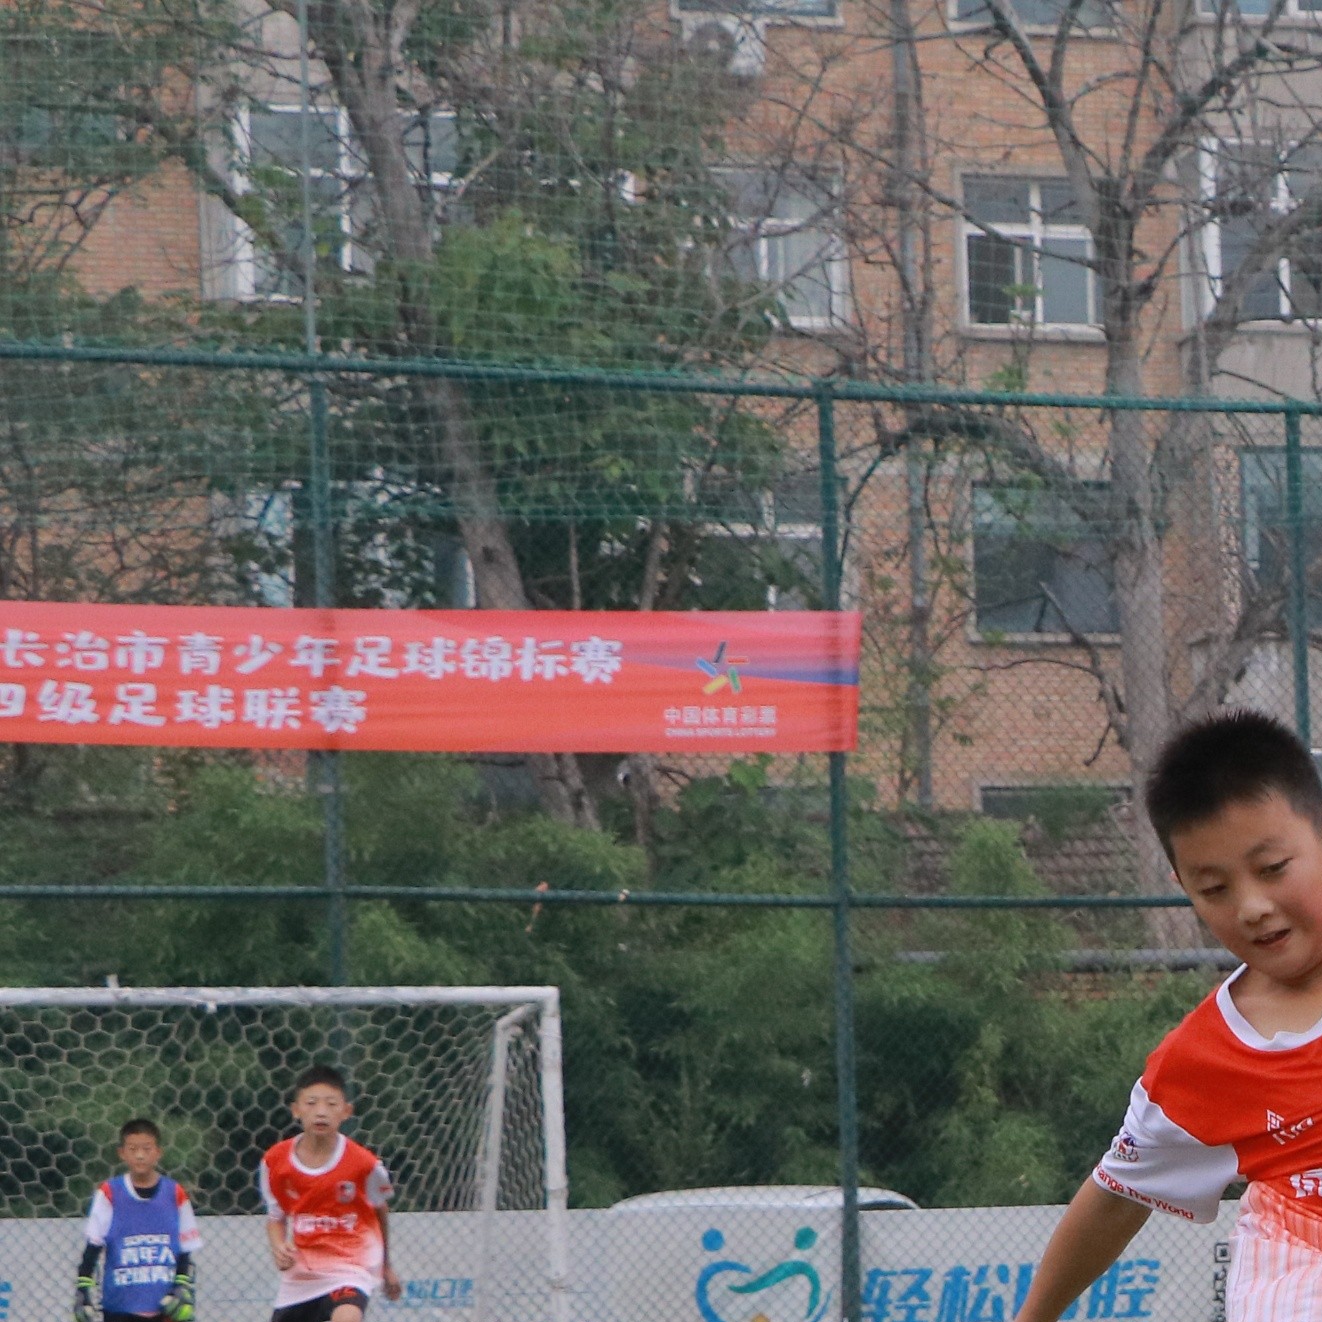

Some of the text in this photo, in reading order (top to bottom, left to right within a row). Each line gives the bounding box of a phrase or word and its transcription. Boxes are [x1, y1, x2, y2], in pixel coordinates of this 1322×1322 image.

[0, 628, 623, 684] 长治市青少年足球锦标赛
[1153, 1198, 1194, 1220] World
